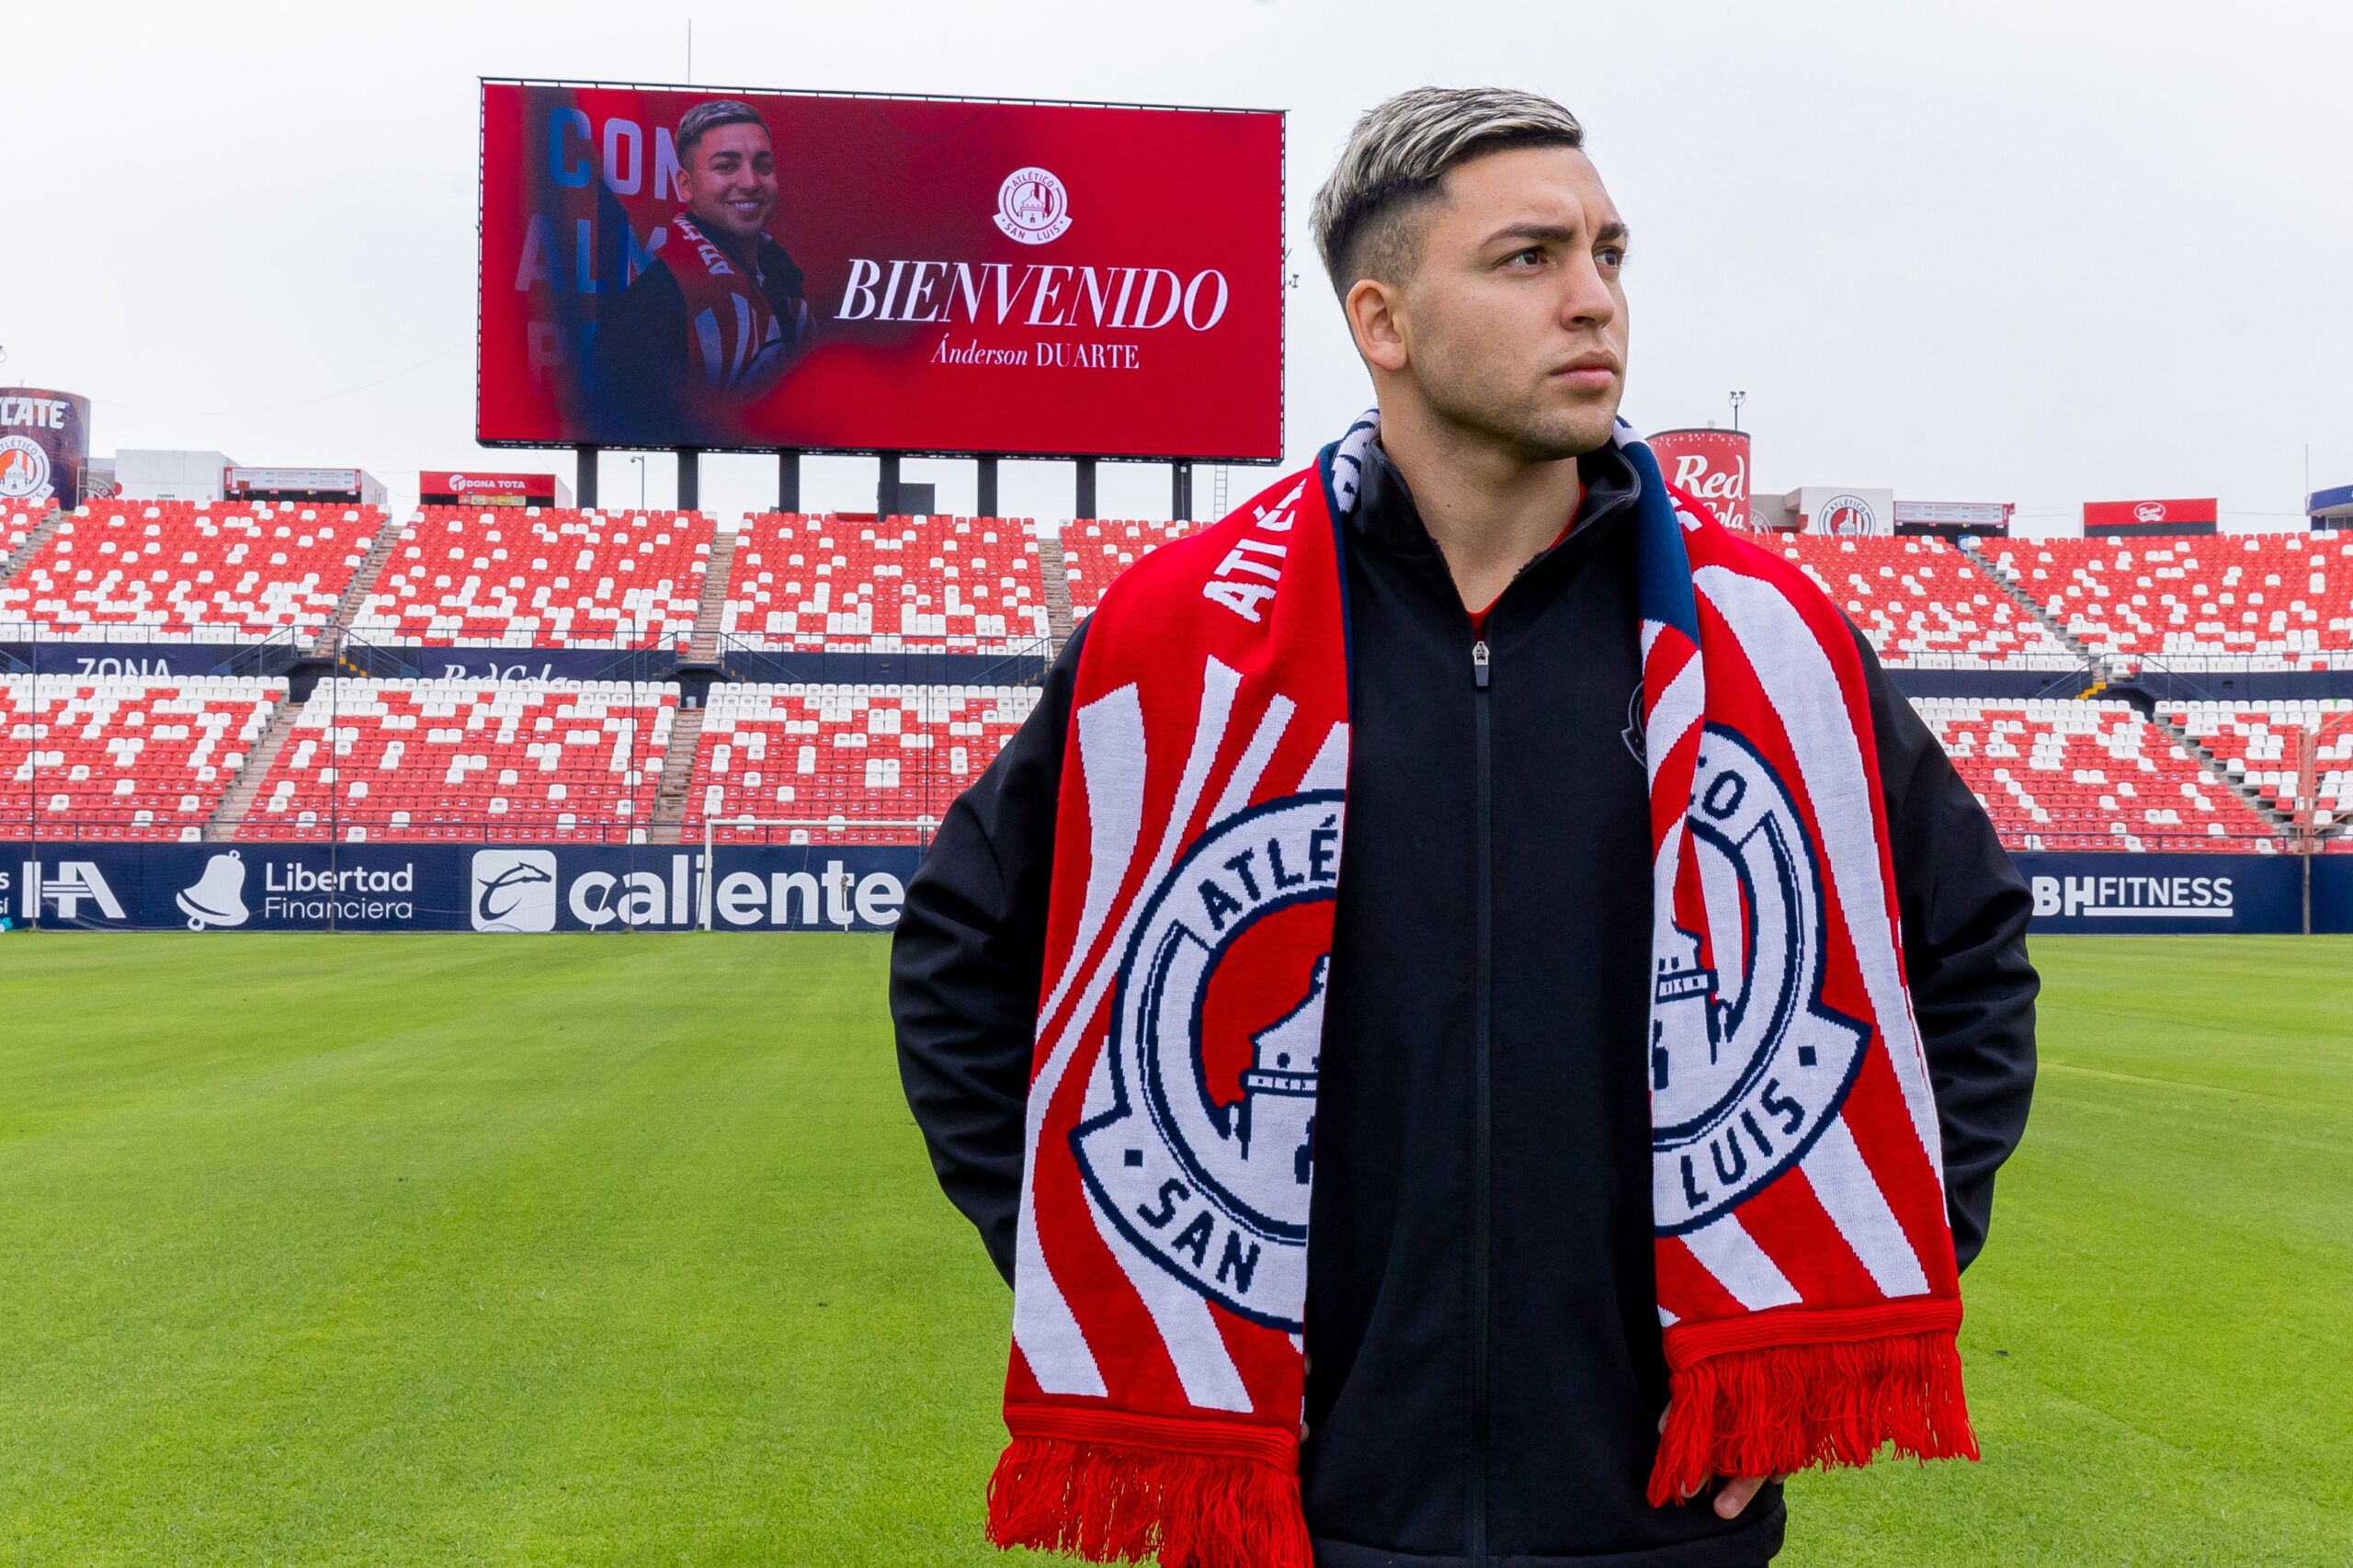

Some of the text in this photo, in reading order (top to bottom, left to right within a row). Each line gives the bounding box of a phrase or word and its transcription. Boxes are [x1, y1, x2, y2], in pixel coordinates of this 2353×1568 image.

[1011, 170, 1054, 187] ATLÉTICO
[1004, 222, 1061, 241] SAN LUIS
[833, 258, 1229, 332] BIENVENIDO
[930, 332, 1141, 369] Ánderson DUARTE
[0, 396, 68, 429] CATE
[498, 480, 526, 489] TOTA
[1674, 454, 1746, 502] Red
[1829, 498, 1867, 514] ATLÉTICO
[265, 862, 413, 892] Libertad
[265, 896, 413, 919] Financiera
[1679, 1078, 1806, 1210] LUIS
[1137, 1177, 1262, 1295] SAN
